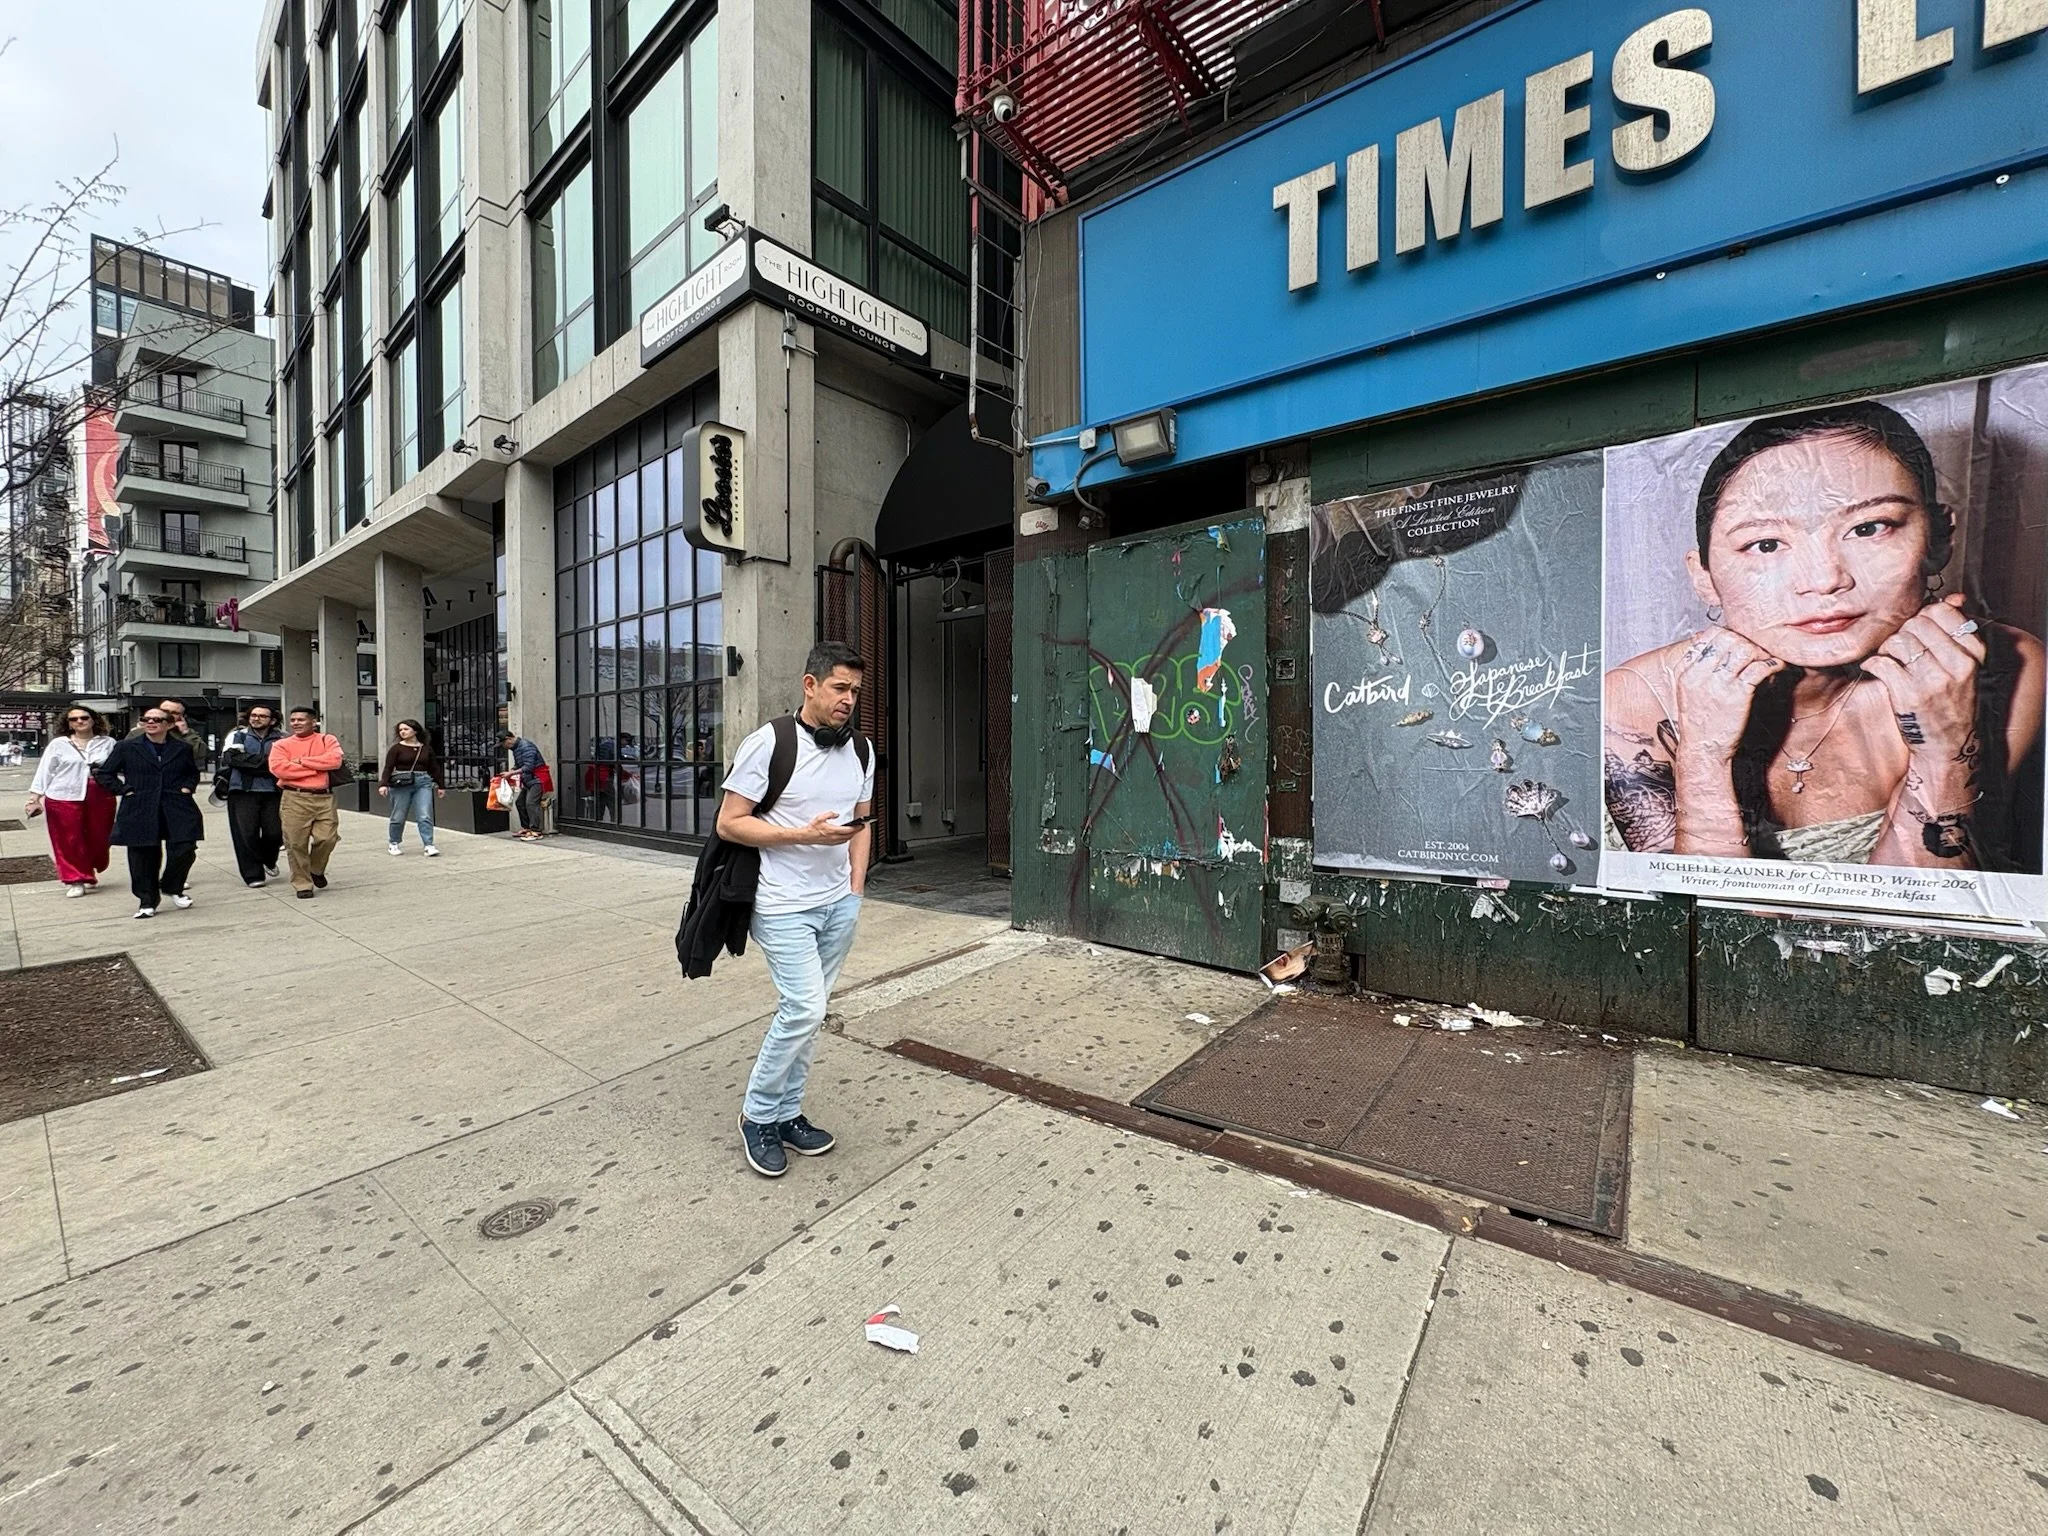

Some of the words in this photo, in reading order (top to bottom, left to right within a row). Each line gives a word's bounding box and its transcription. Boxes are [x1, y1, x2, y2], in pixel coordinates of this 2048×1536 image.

[1273, 8, 1716, 292] TIMES
[657, 260, 724, 332] HIGHLIGHT
[762, 255, 782, 271] THE
[788, 260, 899, 336] HIGHLIGHT
[900, 325, 922, 342] ROOM
[657, 321, 689, 349] ROOFTOP
[690, 296, 721, 324] LOUNGE
[788, 292, 847, 327] ROOFTOP
[851, 325, 896, 352] LOUNGE
[1375, 509, 1397, 519] THE
[1399, 500, 1436, 515] FINEST
[1438, 494, 1463, 507] FINE
[1465, 484, 1517, 504] JEWELRY
[1409, 508, 1453, 528] Limited
[1453, 504, 1496, 520] Edition
[1407, 517, 1480, 537] COLLECTION
[1324, 675, 1412, 713] Catbird
[1450, 654, 1552, 721] Japanese
[1483, 643, 1602, 730] Breakfast
[1398, 849, 1499, 863] CATBIRDNYC.COM
[1425, 841, 1446, 851] EST.
[1447, 842, 1470, 852] 2004
[1649, 861, 1720, 875] MICHELLE
[1723, 865, 1785, 879] ZAUNER
[1788, 869, 1807, 880] for
[1809, 870, 1887, 886] CATBIRD,
[1892, 875, 1940, 888] Winter
[1941, 879, 1977, 891] 2026
[1681, 875, 1719, 888] Writer,
[1721, 878, 1794, 892] frontwoman
[1798, 883, 1811, 895] of
[1811, 883, 1868, 896] Japanese
[1872, 887, 1937, 903] Breakfast
